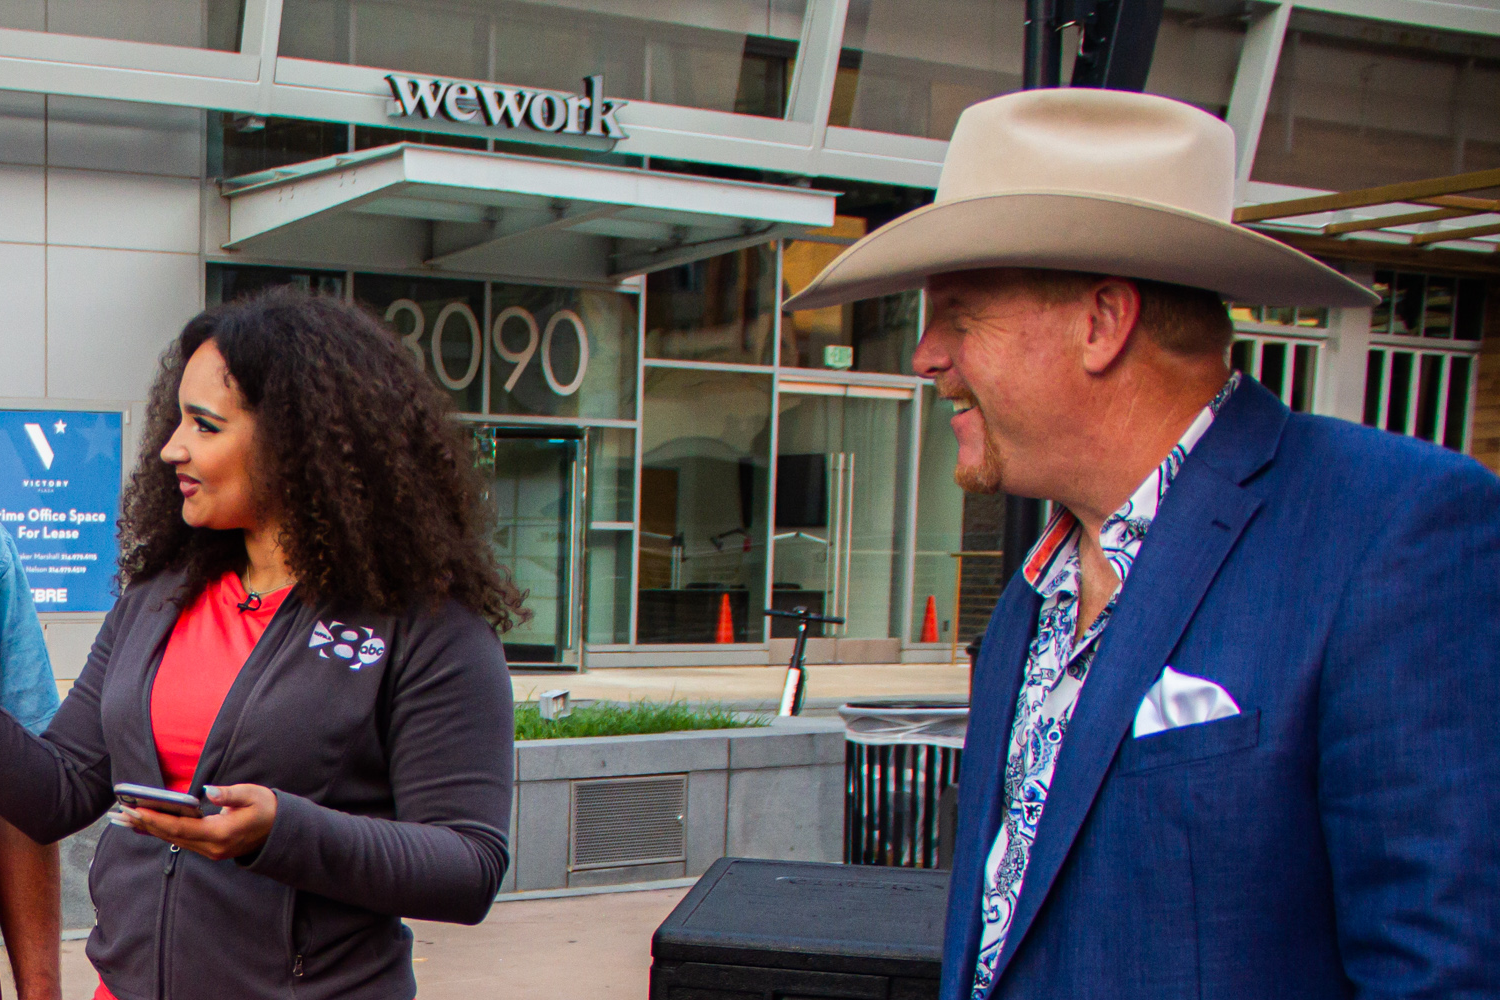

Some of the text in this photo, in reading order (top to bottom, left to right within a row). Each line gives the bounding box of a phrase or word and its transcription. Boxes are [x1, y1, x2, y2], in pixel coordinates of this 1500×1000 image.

[384, 74, 630, 140] wework
[385, 299, 589, 396] 3090
[23, 480, 69, 488] VICTORY
[28, 508, 67, 522] Office
[69, 508, 106, 525] Space
[18, 525, 79, 539] For Lease
[25, 565, 47, 573] Nelson
[361, 643, 385, 657] abc
